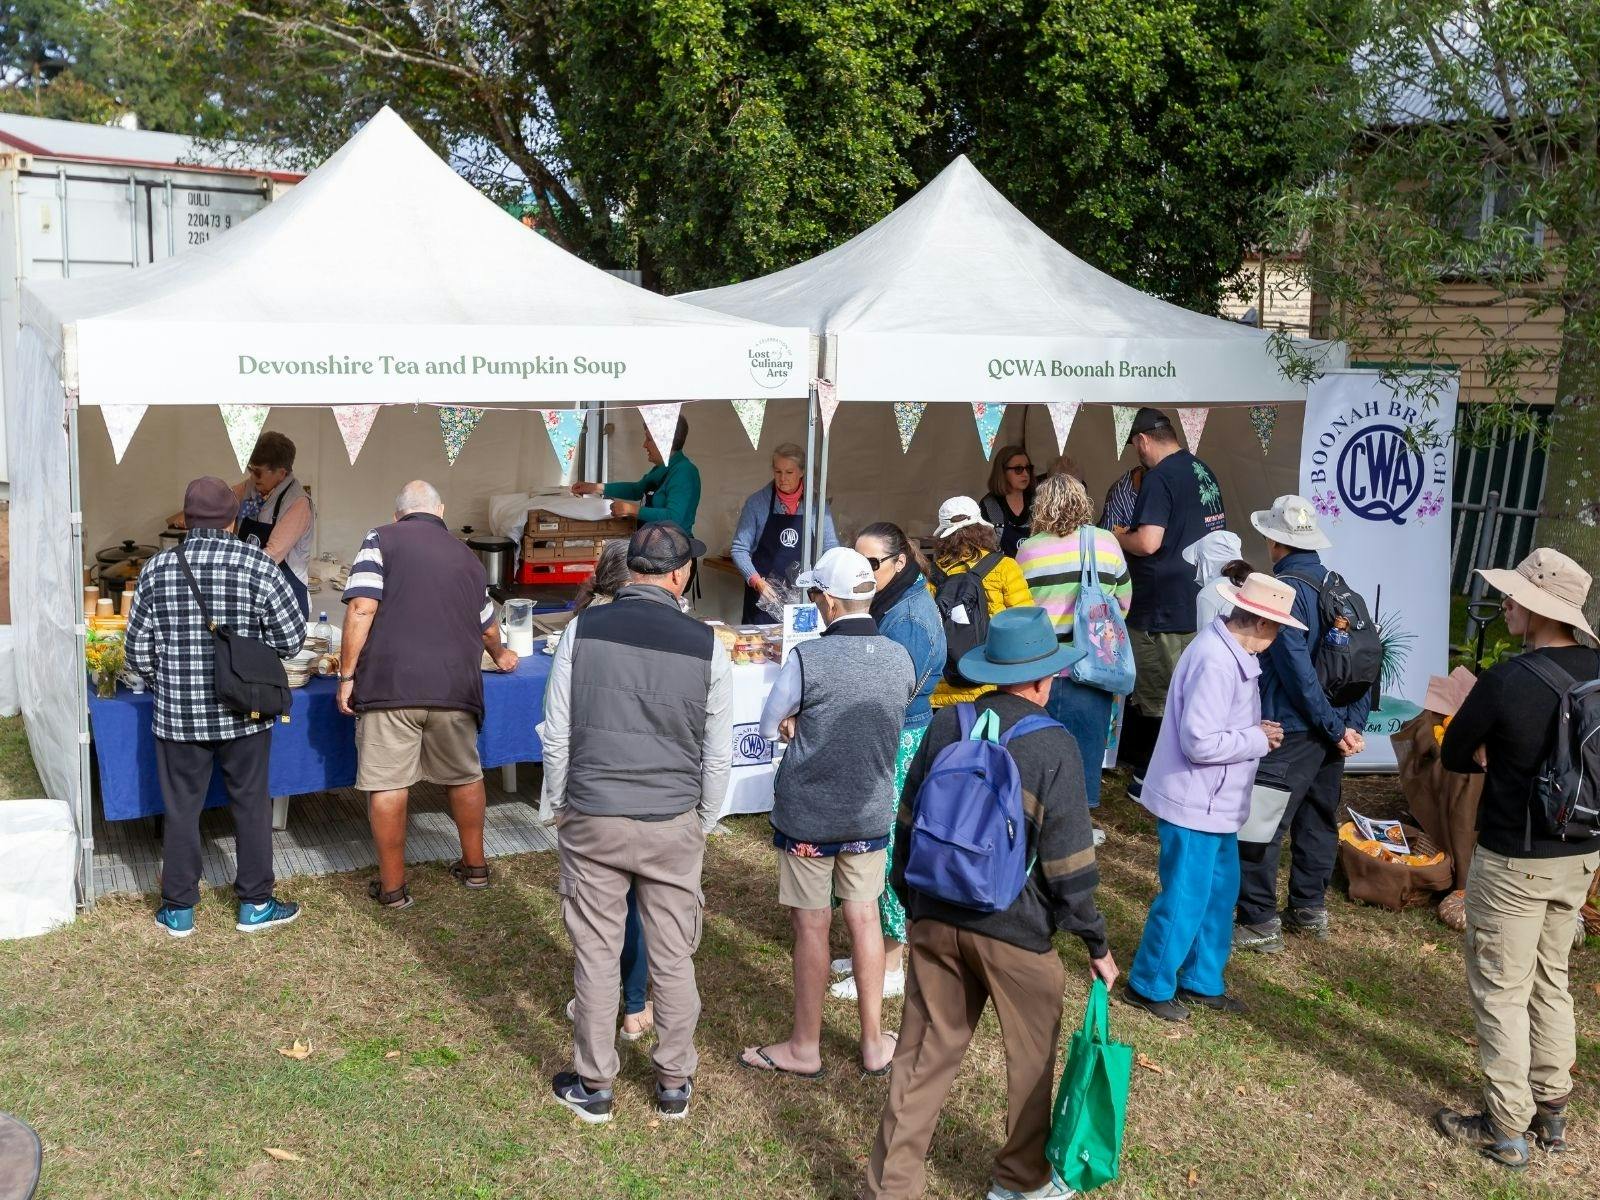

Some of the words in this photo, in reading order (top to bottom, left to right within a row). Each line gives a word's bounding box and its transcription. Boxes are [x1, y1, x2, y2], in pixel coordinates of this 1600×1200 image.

[187, 213, 221, 228] 220473
[225, 214, 231, 229] 9
[748, 349, 770, 359] Lost
[238, 354, 374, 375] Devonshire
[378, 355, 420, 375] Tea
[425, 355, 466, 375] and
[472, 355, 569, 379] Pumpkin
[573, 356, 627, 379] Soup
[751, 358, 793, 370] Culinary
[987, 359, 1047, 379] QCWA
[1050, 360, 1114, 378] Boonah
[1119, 360, 1177, 378] Branch
[766, 368, 788, 377] Arts
[1311, 401, 1380, 484] BOONAH
